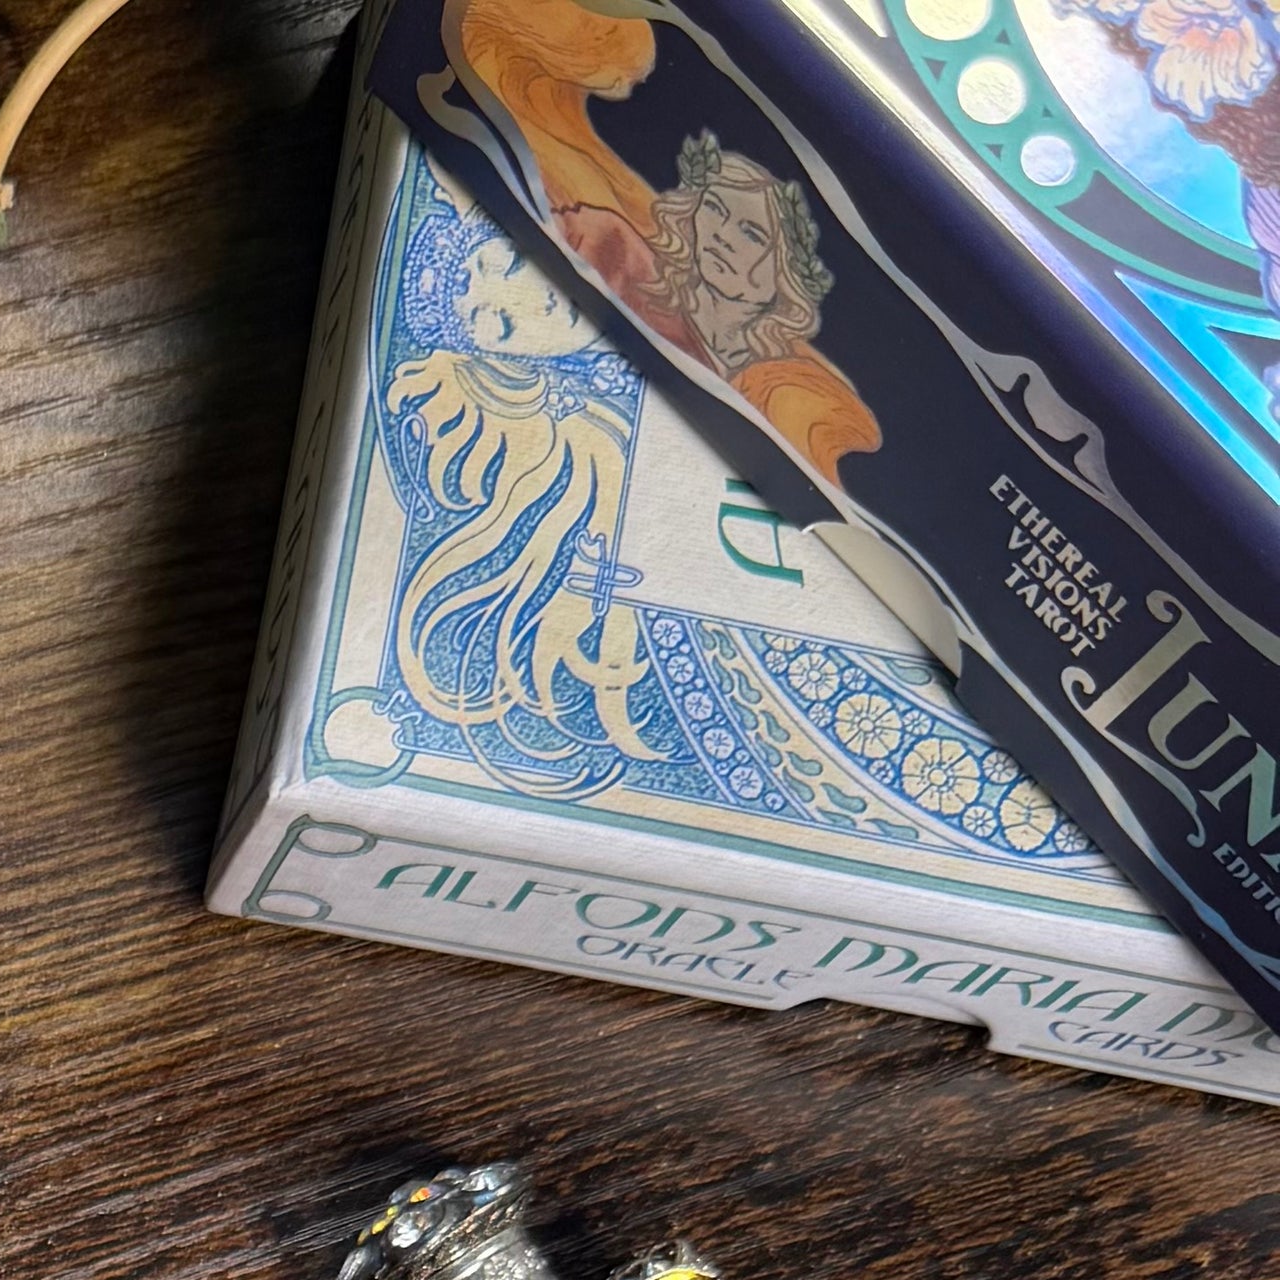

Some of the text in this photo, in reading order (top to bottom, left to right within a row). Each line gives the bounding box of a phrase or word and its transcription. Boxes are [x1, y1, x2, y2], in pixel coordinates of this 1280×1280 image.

[989, 474, 1127, 623] ETHEREAL
[1004, 563, 1095, 656] TAROT
[1008, 526, 1111, 640] VISIONS
[1061, 590, 1280, 873] LUN
[375, 863, 802, 951] ALFONS
[812, 937, 1150, 1021] MARIA
[1213, 842, 1280, 926] EDITI
[576, 935, 1244, 1067] ORACLE CARDS
